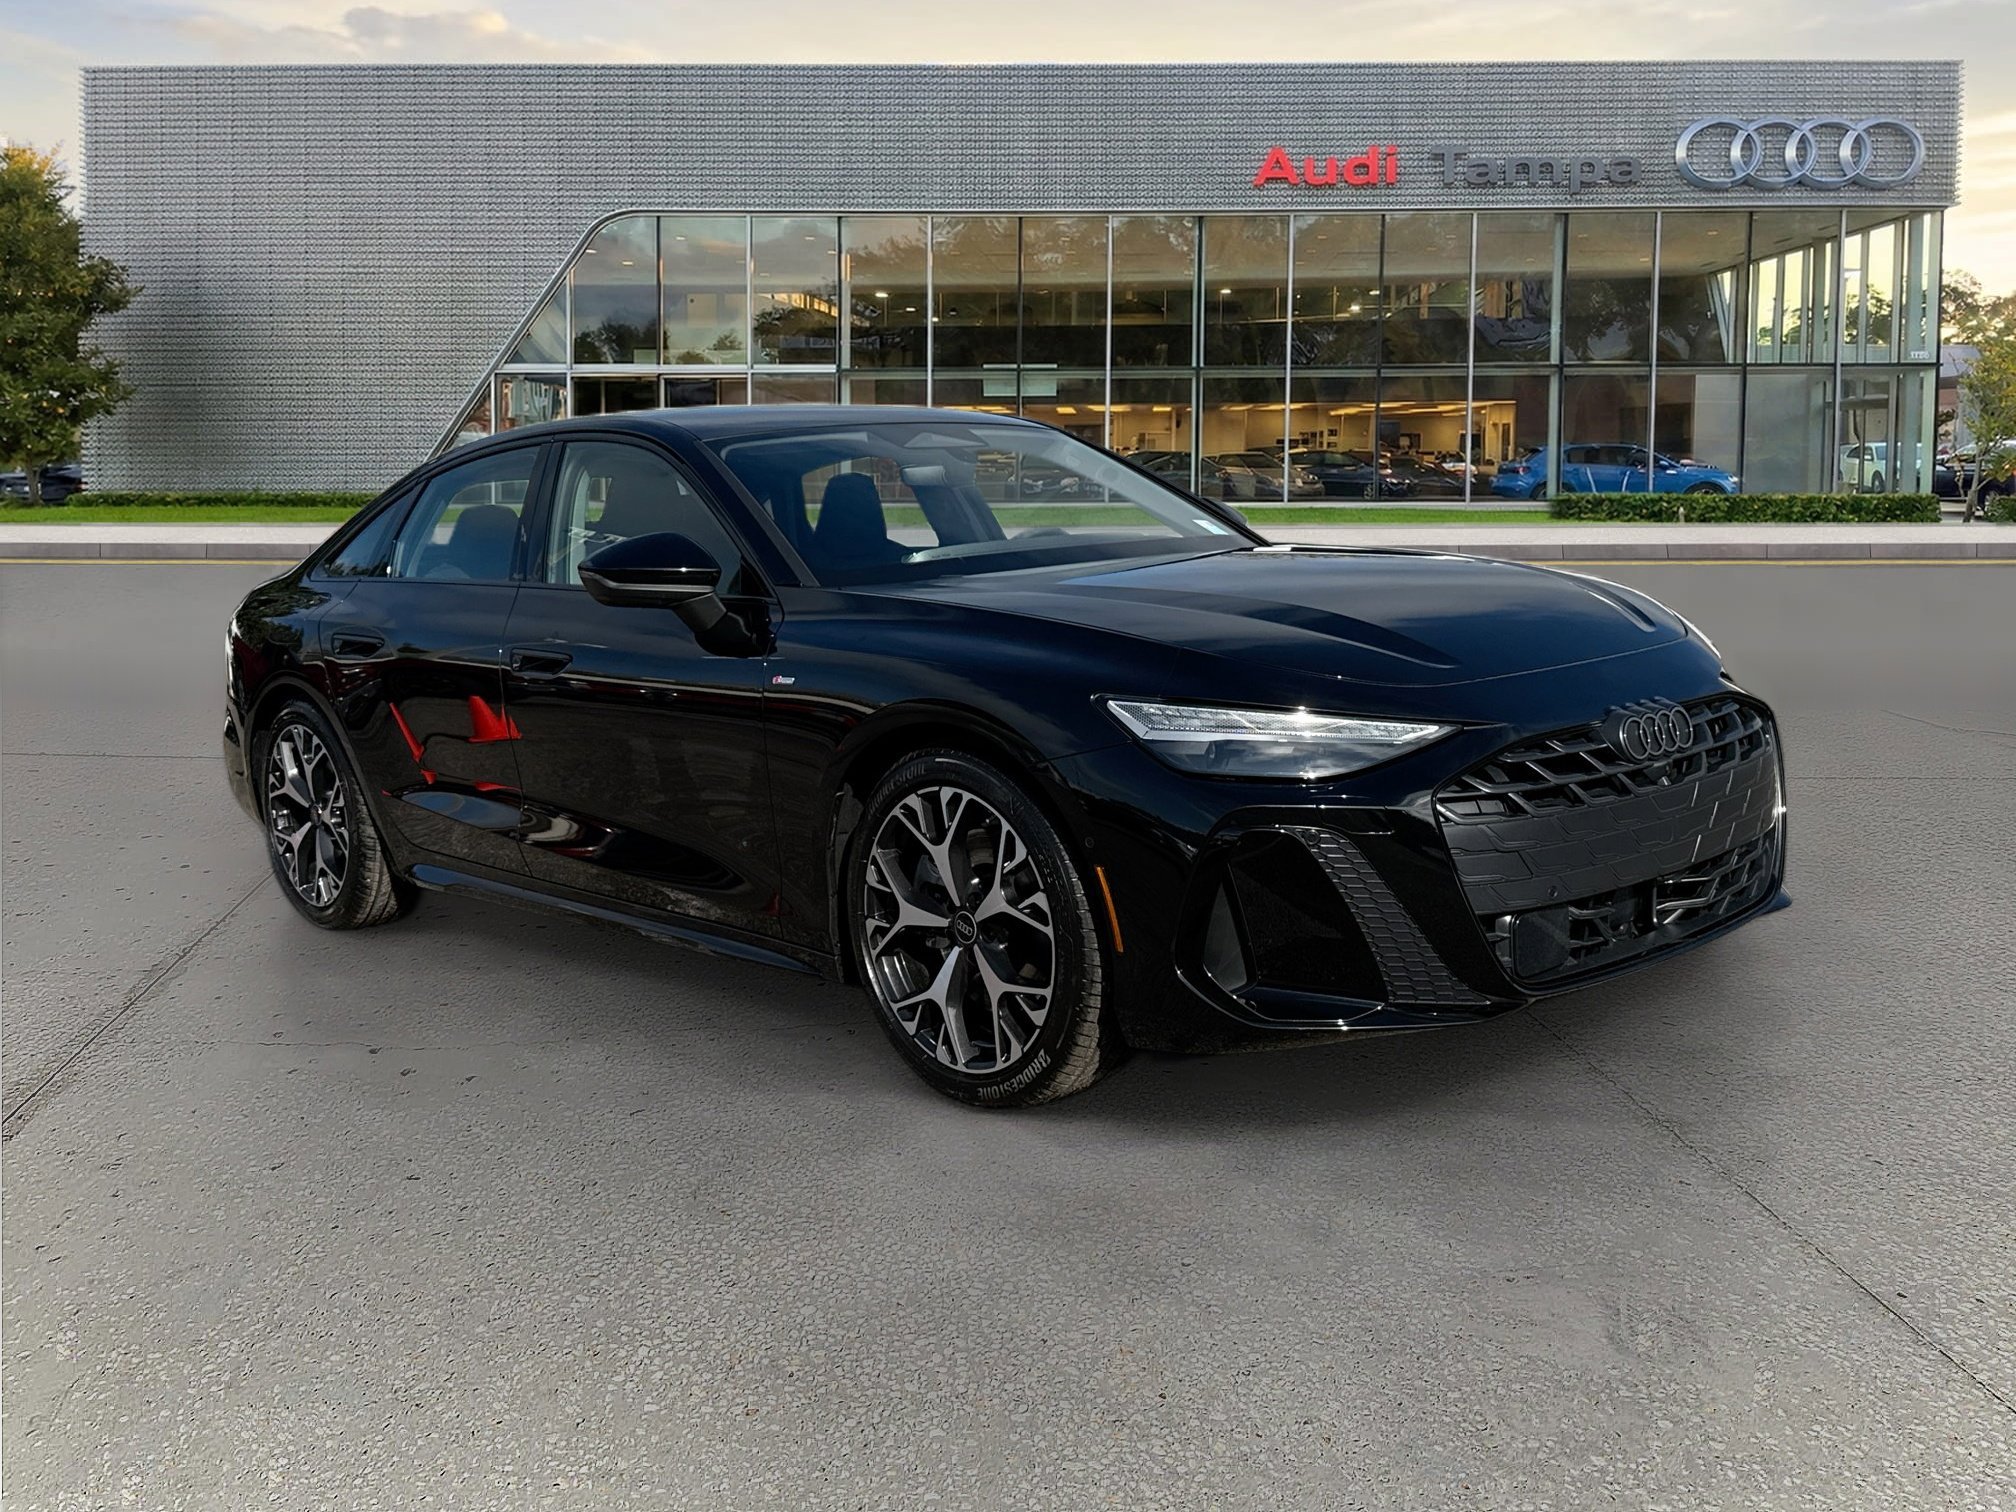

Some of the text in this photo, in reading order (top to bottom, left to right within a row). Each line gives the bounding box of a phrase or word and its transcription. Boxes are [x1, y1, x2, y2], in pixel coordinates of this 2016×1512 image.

[1253, 145, 1642, 194] Audi Tampa
[976, 1048, 1051, 1100] BRIDGESTONE
